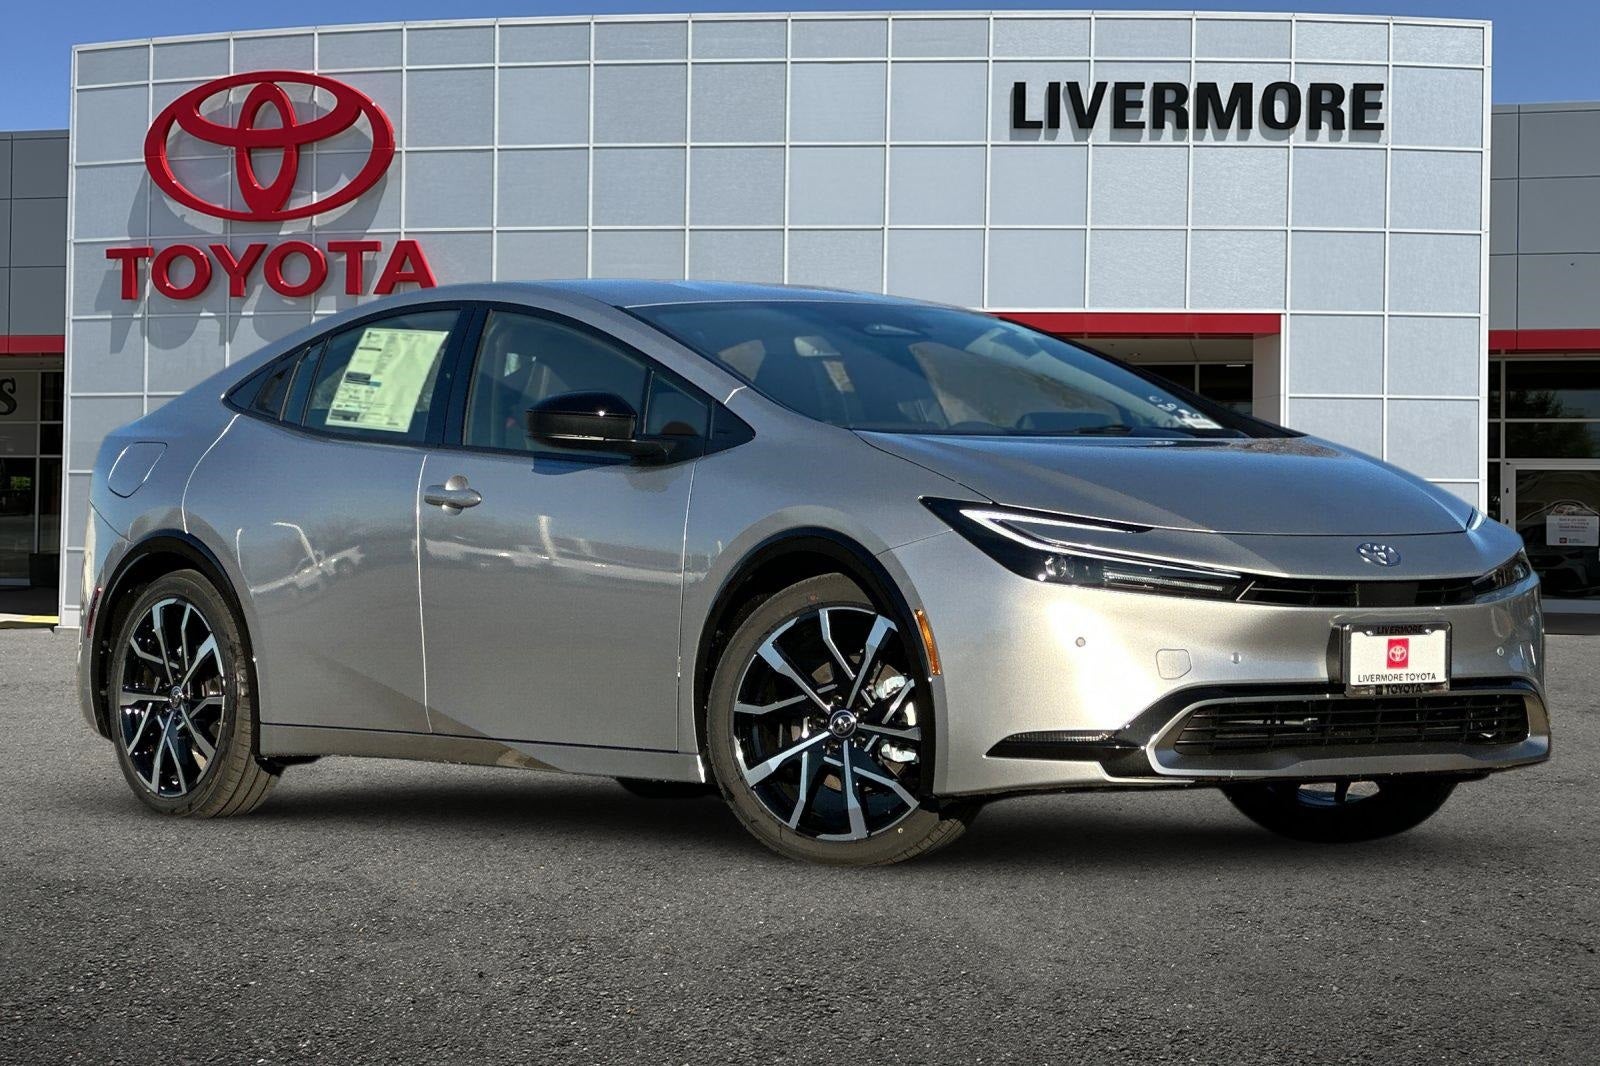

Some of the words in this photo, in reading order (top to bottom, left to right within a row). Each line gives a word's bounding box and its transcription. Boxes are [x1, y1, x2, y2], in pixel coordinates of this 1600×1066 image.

[1012, 81, 1385, 131] LIVERMORE
[105, 239, 437, 300] TOYOTA
[1377, 625, 1423, 634] LIVERMORE
[1357, 673, 1403, 683] LIVERMORE
[1405, 672, 1437, 682] TOYOTA
[1386, 684, 1423, 694] TOYOTA
